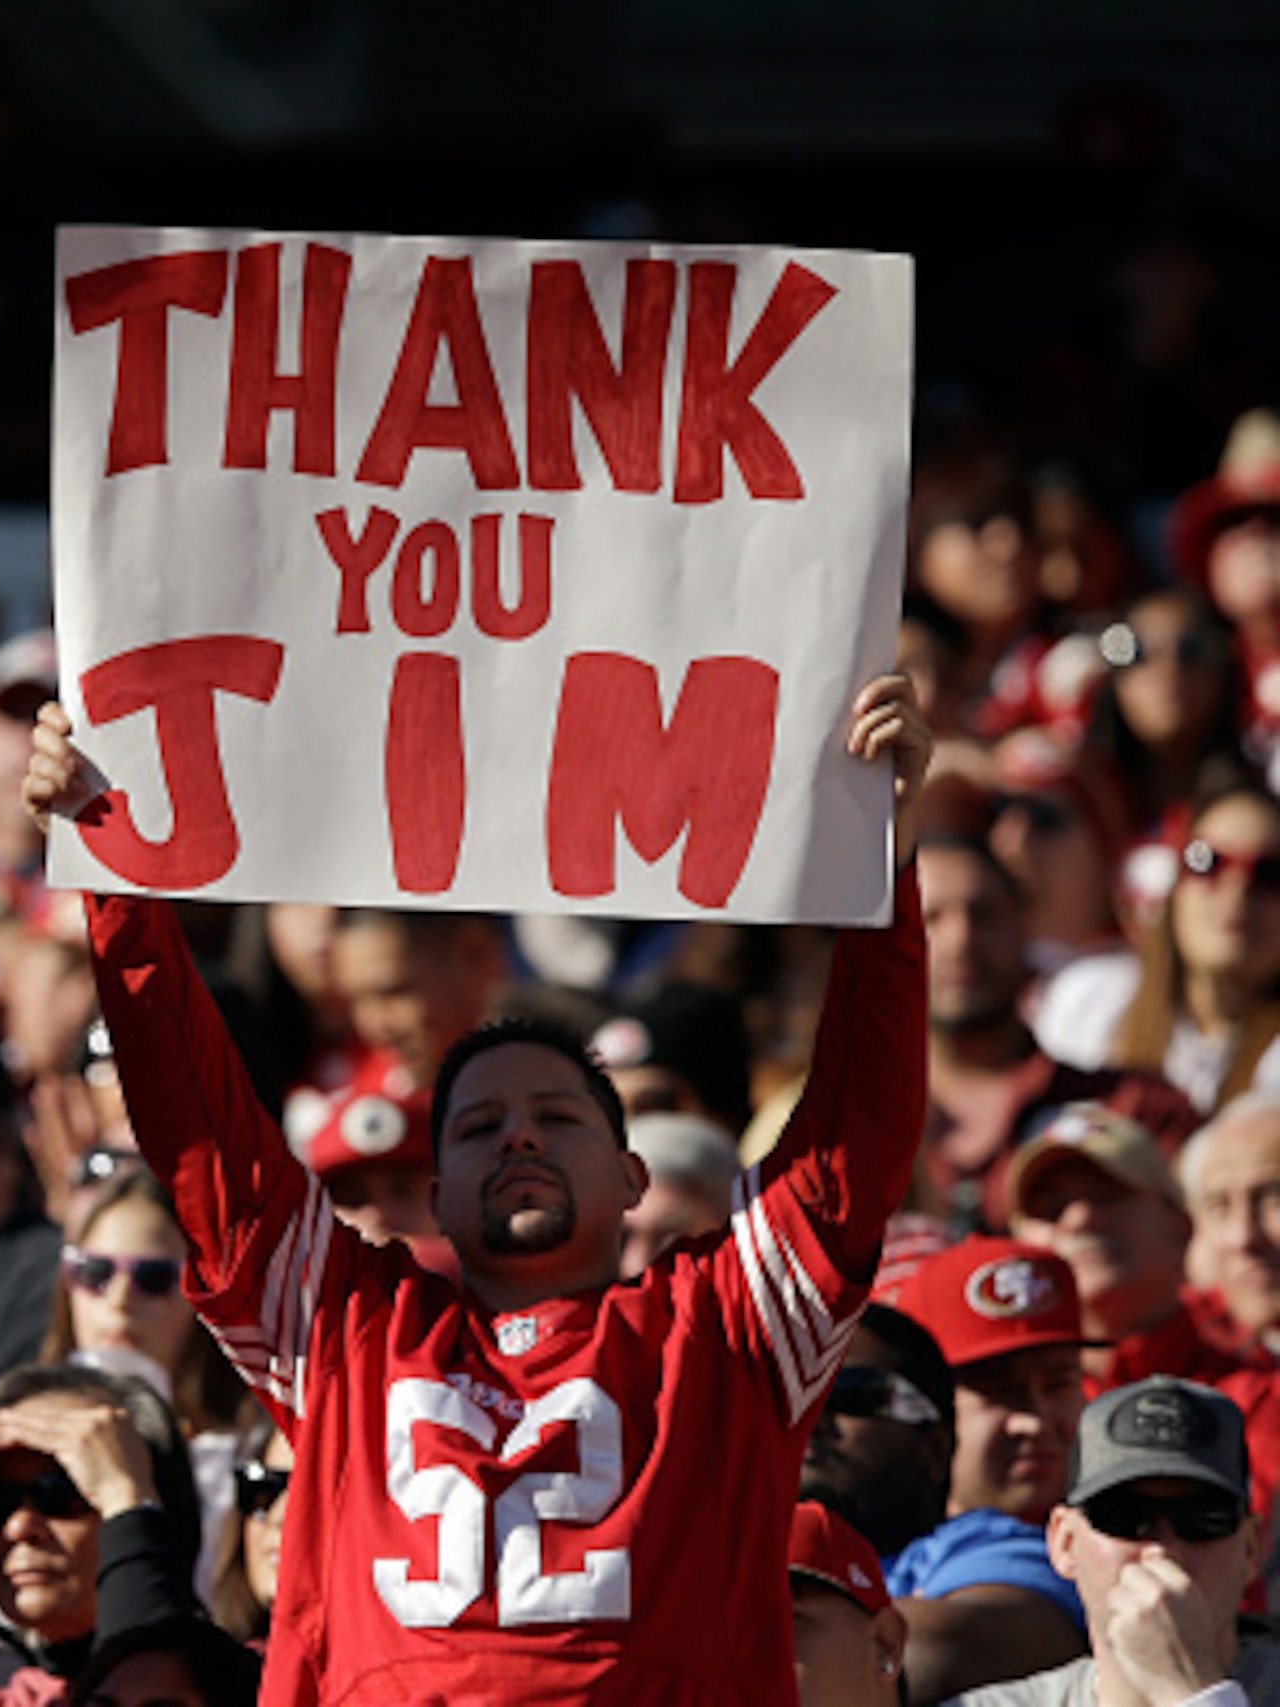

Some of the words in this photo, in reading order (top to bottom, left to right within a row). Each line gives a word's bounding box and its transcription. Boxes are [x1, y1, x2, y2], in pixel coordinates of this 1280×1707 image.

[65, 242, 839, 504] THANK
[315, 505, 555, 641] YOU
[75, 635, 780, 910] JIM
[372, 1376, 631, 1628] 52
